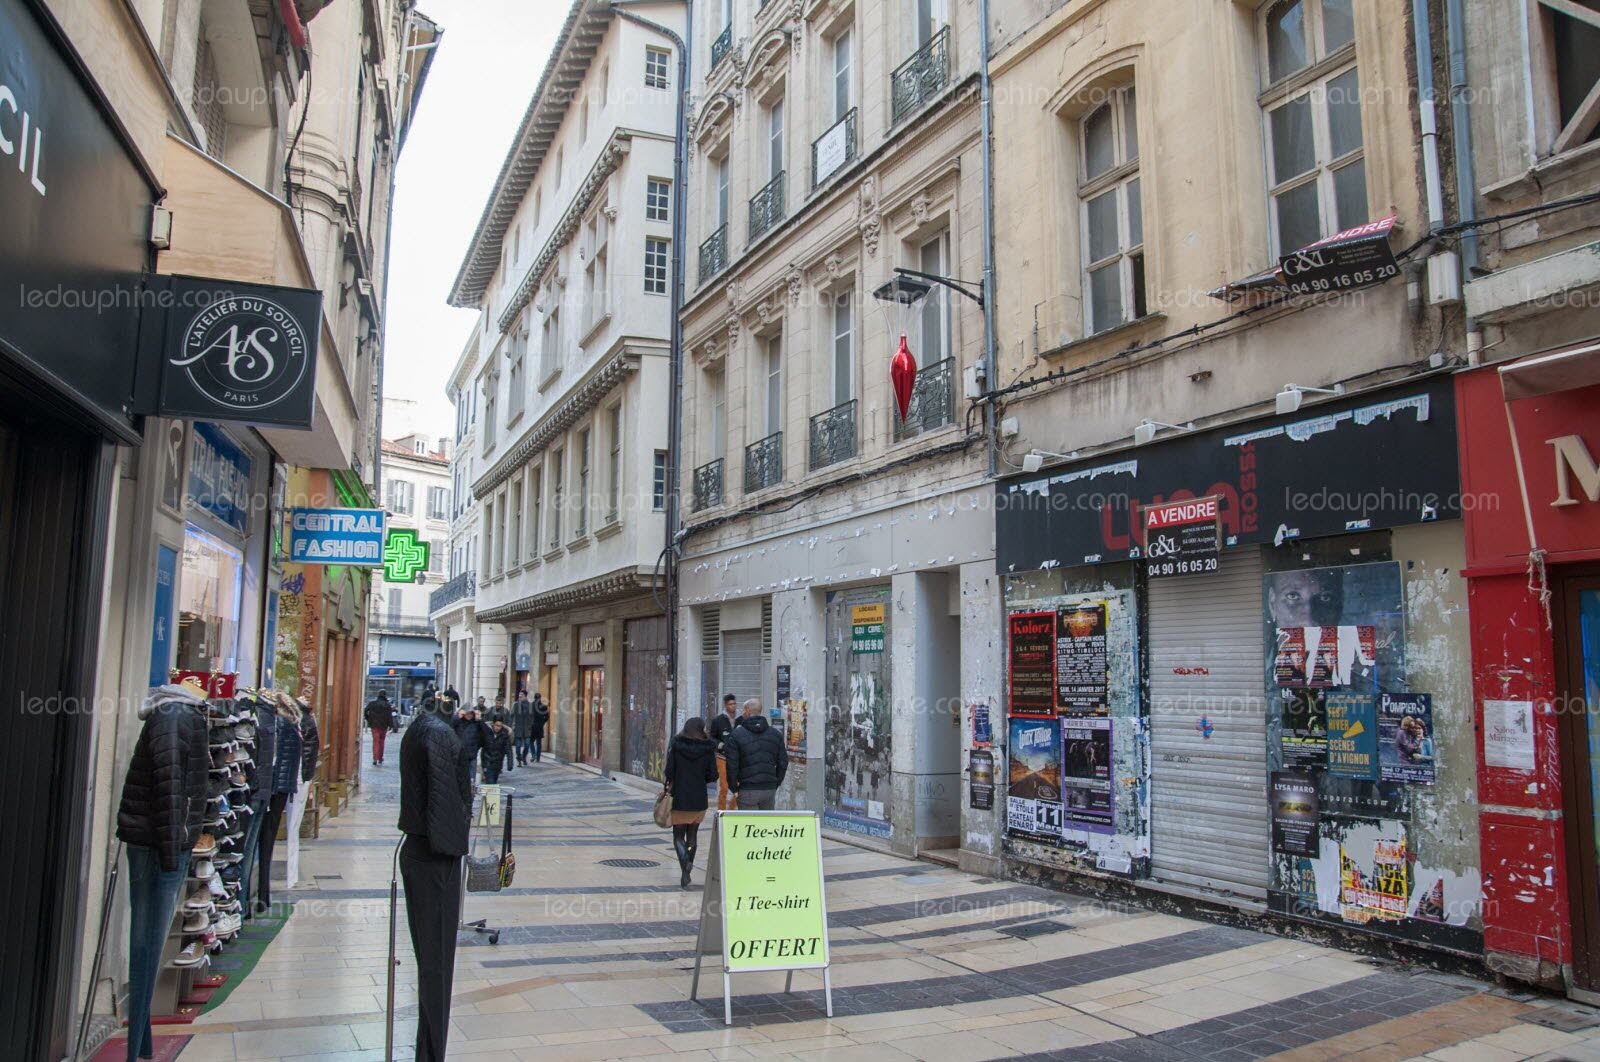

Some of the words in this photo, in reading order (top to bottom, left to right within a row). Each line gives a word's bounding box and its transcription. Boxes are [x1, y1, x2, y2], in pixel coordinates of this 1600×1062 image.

[1291, 282, 1309, 293] 04
[1311, 279, 1329, 290] 90
[1333, 275, 1351, 287] 16
[1354, 270, 1374, 283] 05
[1376, 265, 1396, 278] 20
[190, 302, 237, 347] L'ATELIER
[242, 301, 263, 312] DU
[265, 306, 302, 357] SOURCIL
[224, 391, 259, 402] PARIS
[1103, 483, 1240, 551] LUA
[1148, 511, 1158, 526] A
[1160, 501, 1216, 523] VENDRE
[293, 513, 382, 533] CENTRAL
[294, 539, 379, 558] FASHION
[1148, 564, 1160, 576] 04
[1162, 563, 1174, 575] 90
[1176, 561, 1188, 573] 16
[1190, 560, 1203, 571] 05
[1205, 558, 1217, 570] 20
[1274, 783, 1291, 792] LYSA
[1292, 785, 1315, 794] MARO
[1009, 819, 1034, 830] RENARD
[1038, 807, 1059, 825] 11
[745, 824, 805, 838] Tee-shirt
[746, 846, 792, 860] acheté
[748, 895, 810, 910] Tee-shirt
[730, 937, 820, 960] OFFERT
